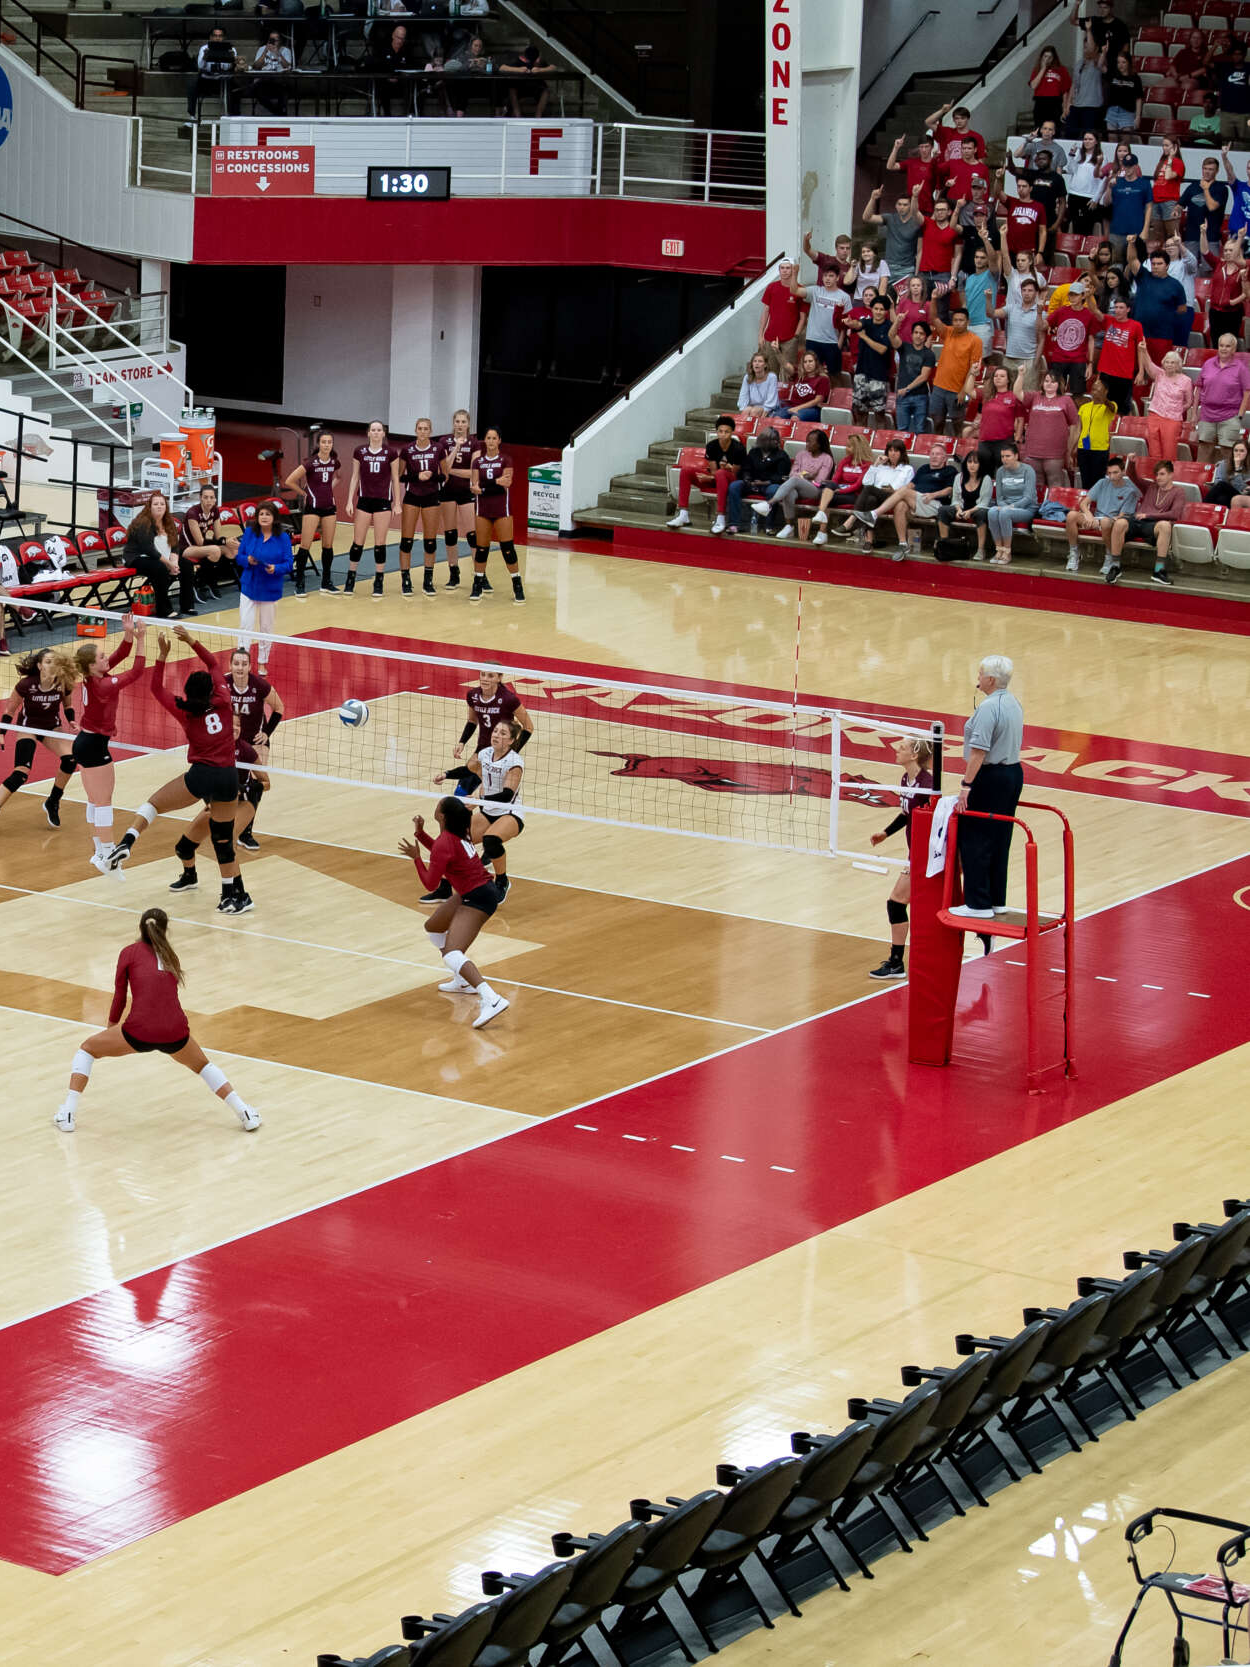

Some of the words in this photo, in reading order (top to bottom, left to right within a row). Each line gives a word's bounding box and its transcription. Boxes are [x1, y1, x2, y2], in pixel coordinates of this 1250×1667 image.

[227, 150, 300, 160] RESTROOMS
[529, 128, 564, 175] F
[226, 163, 310, 173] CONCESSIONS
[380, 173, 429, 193] 1:30
[665, 240, 680, 255] EXIT
[89, 370, 117, 386] TEAM
[121, 366, 153, 381] STORE
[456, 453, 463, 463] 5
[369, 461, 380, 473] 10
[419, 460, 429, 470] 11
[486, 468, 494, 479] 6
[533, 490, 560, 499] RECYCLE
[233, 702, 250, 715] 14
[205, 712, 222, 734] 8
[482, 713, 491, 727] 3
